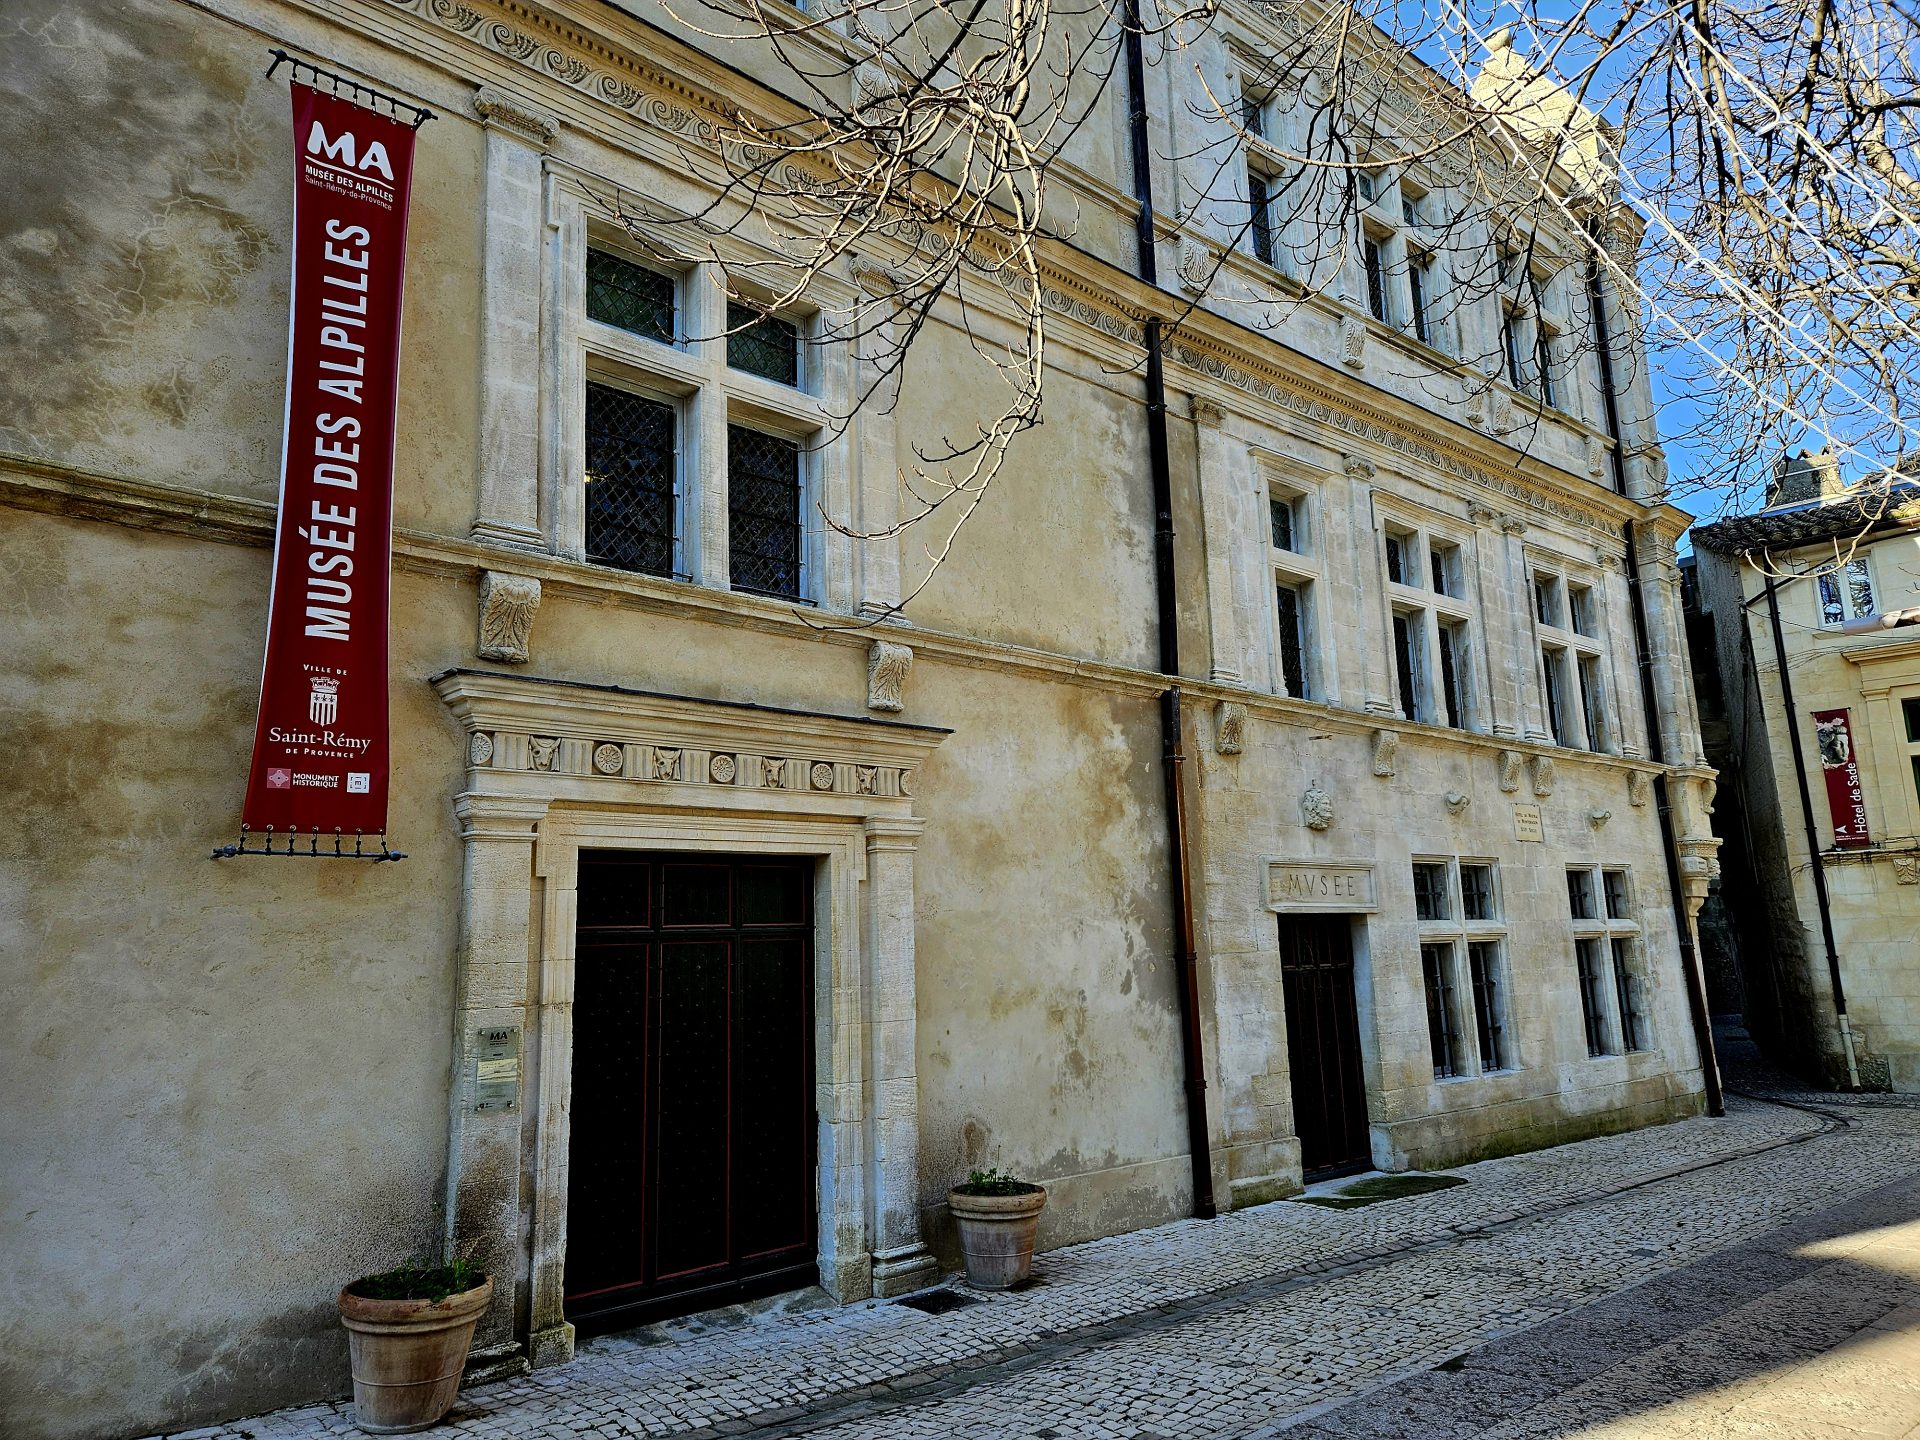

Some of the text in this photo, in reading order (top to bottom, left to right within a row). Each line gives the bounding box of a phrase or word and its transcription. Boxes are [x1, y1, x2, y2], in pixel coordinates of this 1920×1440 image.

[307, 121, 394, 181] MA
[304, 174, 392, 211] Saint-Rémy-de-Provence
[305, 164, 394, 203] MUSÉE DES ALPILLES
[298, 218, 371, 642] MUSÉE DES ALPILLES
[268, 726, 372, 755] Saint-Rémy
[292, 772, 340, 782] MONUMENT
[292, 779, 339, 789] HISTORIQUE
[1845, 762, 1868, 834] Hôtel de Sade
[489, 1031, 508, 1041] MA
